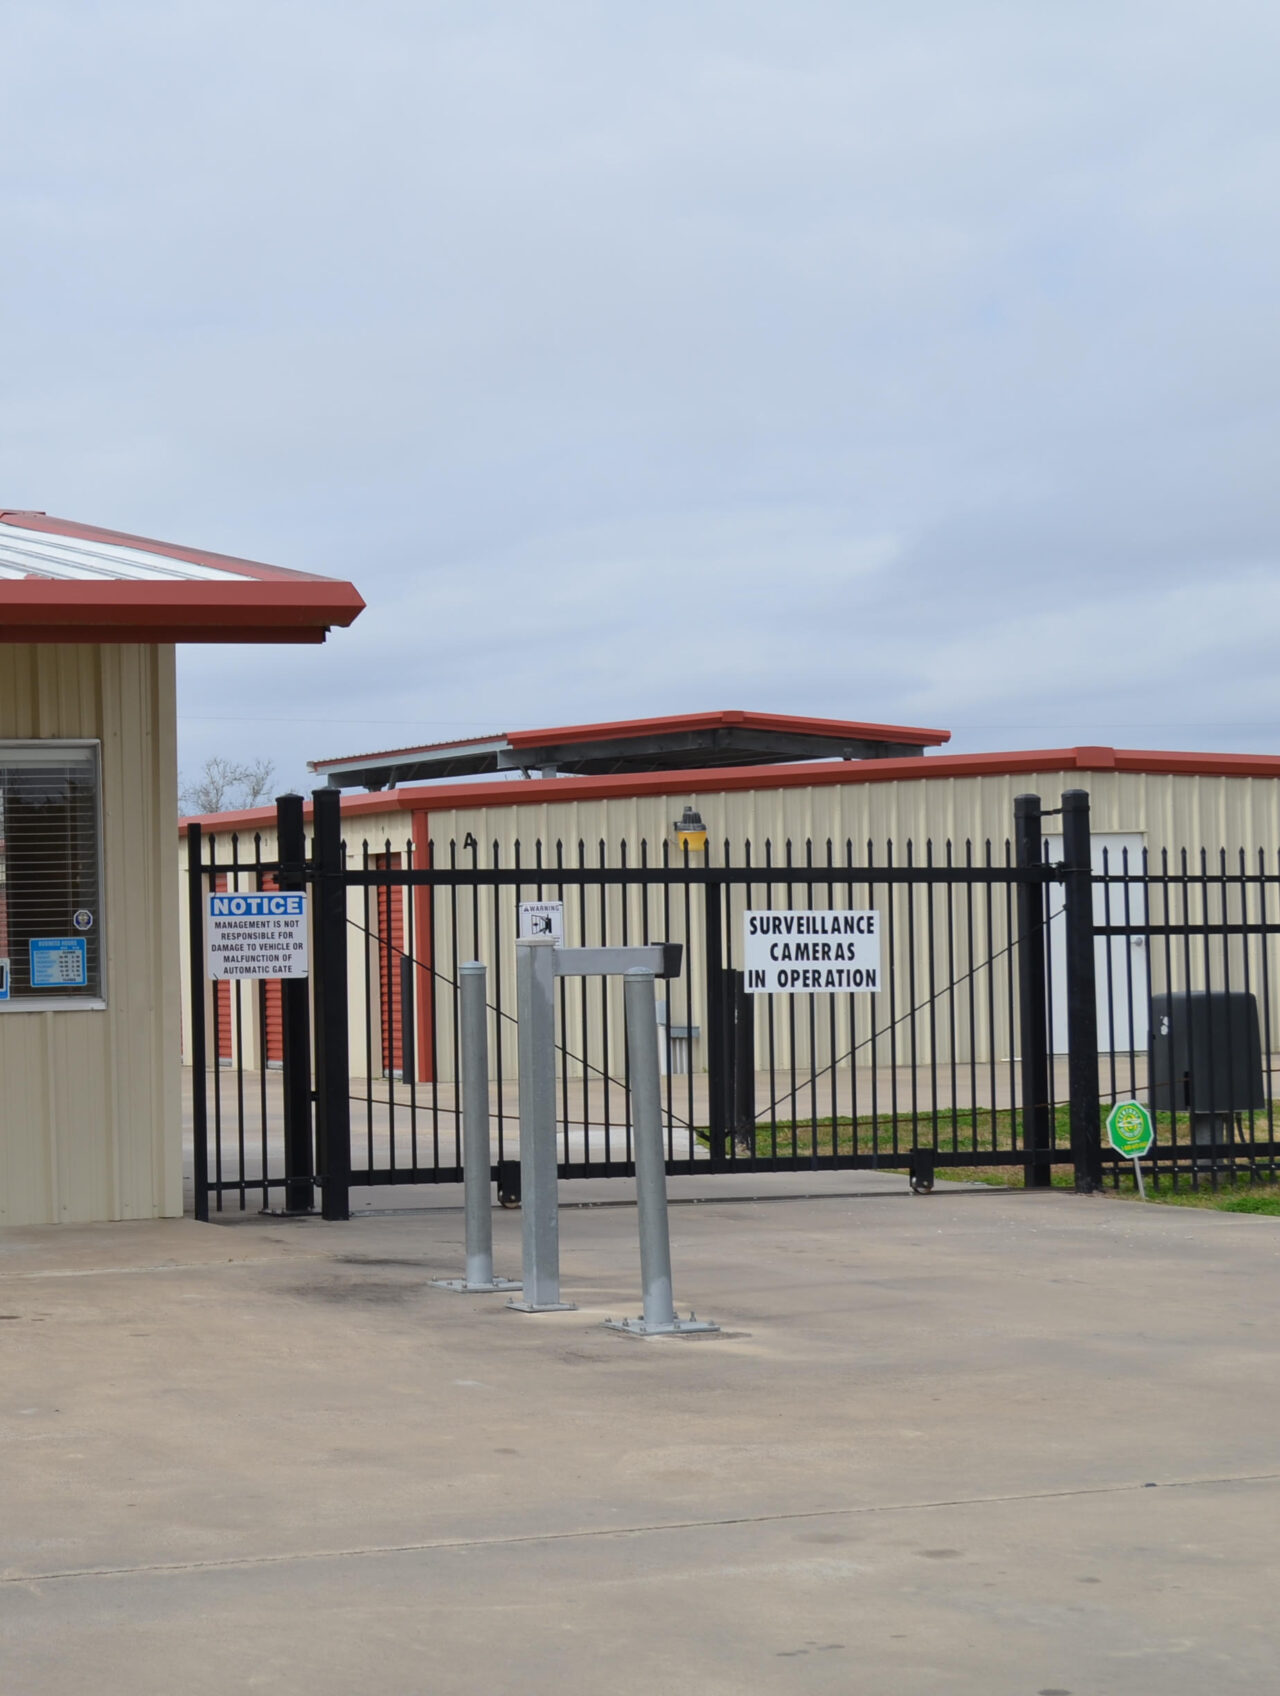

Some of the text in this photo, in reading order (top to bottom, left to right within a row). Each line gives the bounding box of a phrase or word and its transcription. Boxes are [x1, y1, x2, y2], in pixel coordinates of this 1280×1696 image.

[214, 898, 300, 914] NOTICE
[749, 916, 874, 935] SURVEILLANCE
[221, 932, 275, 940] RESPONSIBLE
[259, 943, 290, 951] VEHICLE
[292, 942, 304, 950] OR
[770, 943, 856, 961] CAMERAS
[223, 954, 280, 963] MALFUNCTION
[223, 965, 292, 974] AUTOMATIC GATE
[748, 968, 877, 988] IN OPERATION
